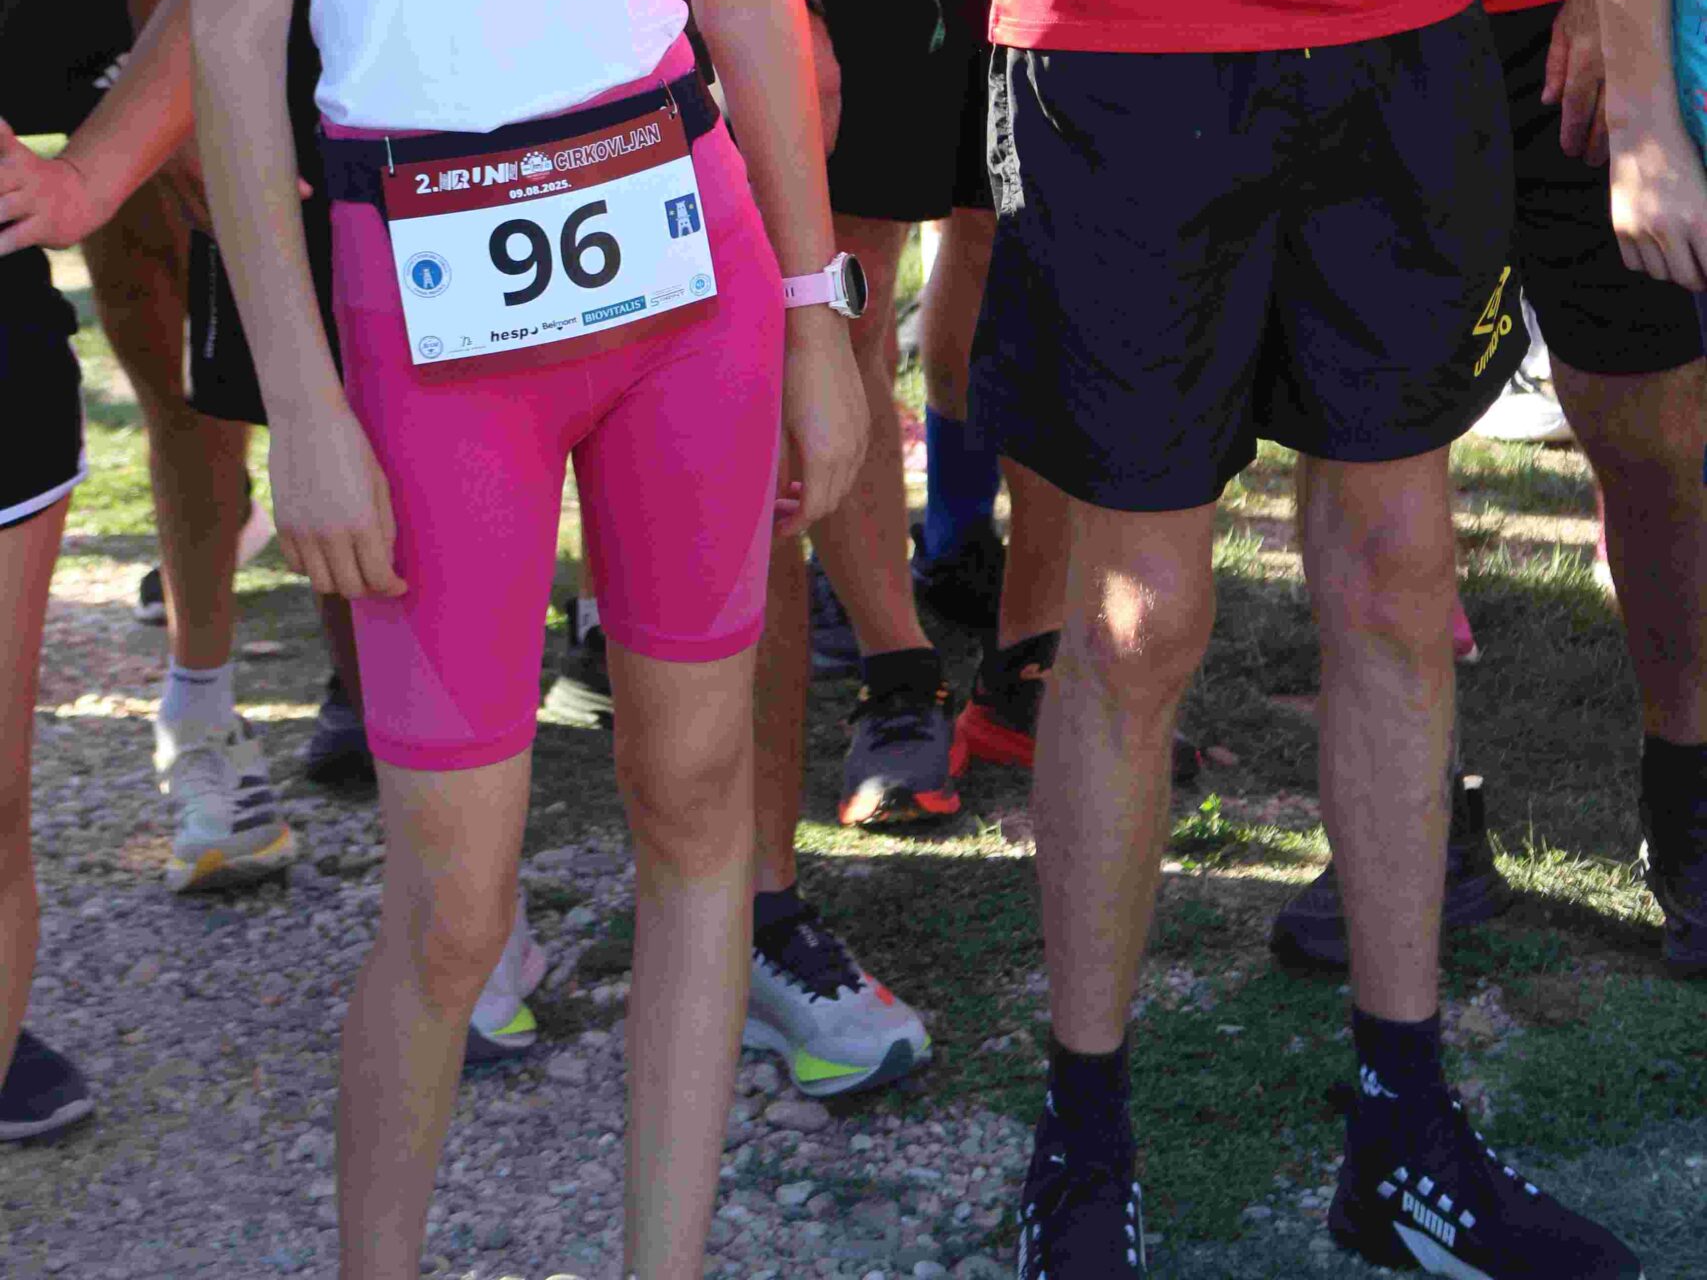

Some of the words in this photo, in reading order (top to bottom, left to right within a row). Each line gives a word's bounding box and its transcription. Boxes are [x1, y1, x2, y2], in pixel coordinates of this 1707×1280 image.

[414, 173, 440, 195] 2.
[553, 122, 662, 172] CIRKOVLJAN
[508, 179, 572, 200] 09.08.2025.
[488, 198, 622, 307] 96
[584, 298, 642, 324] BIOVITALIS
[1402, 1190, 1457, 1248] PUMA
